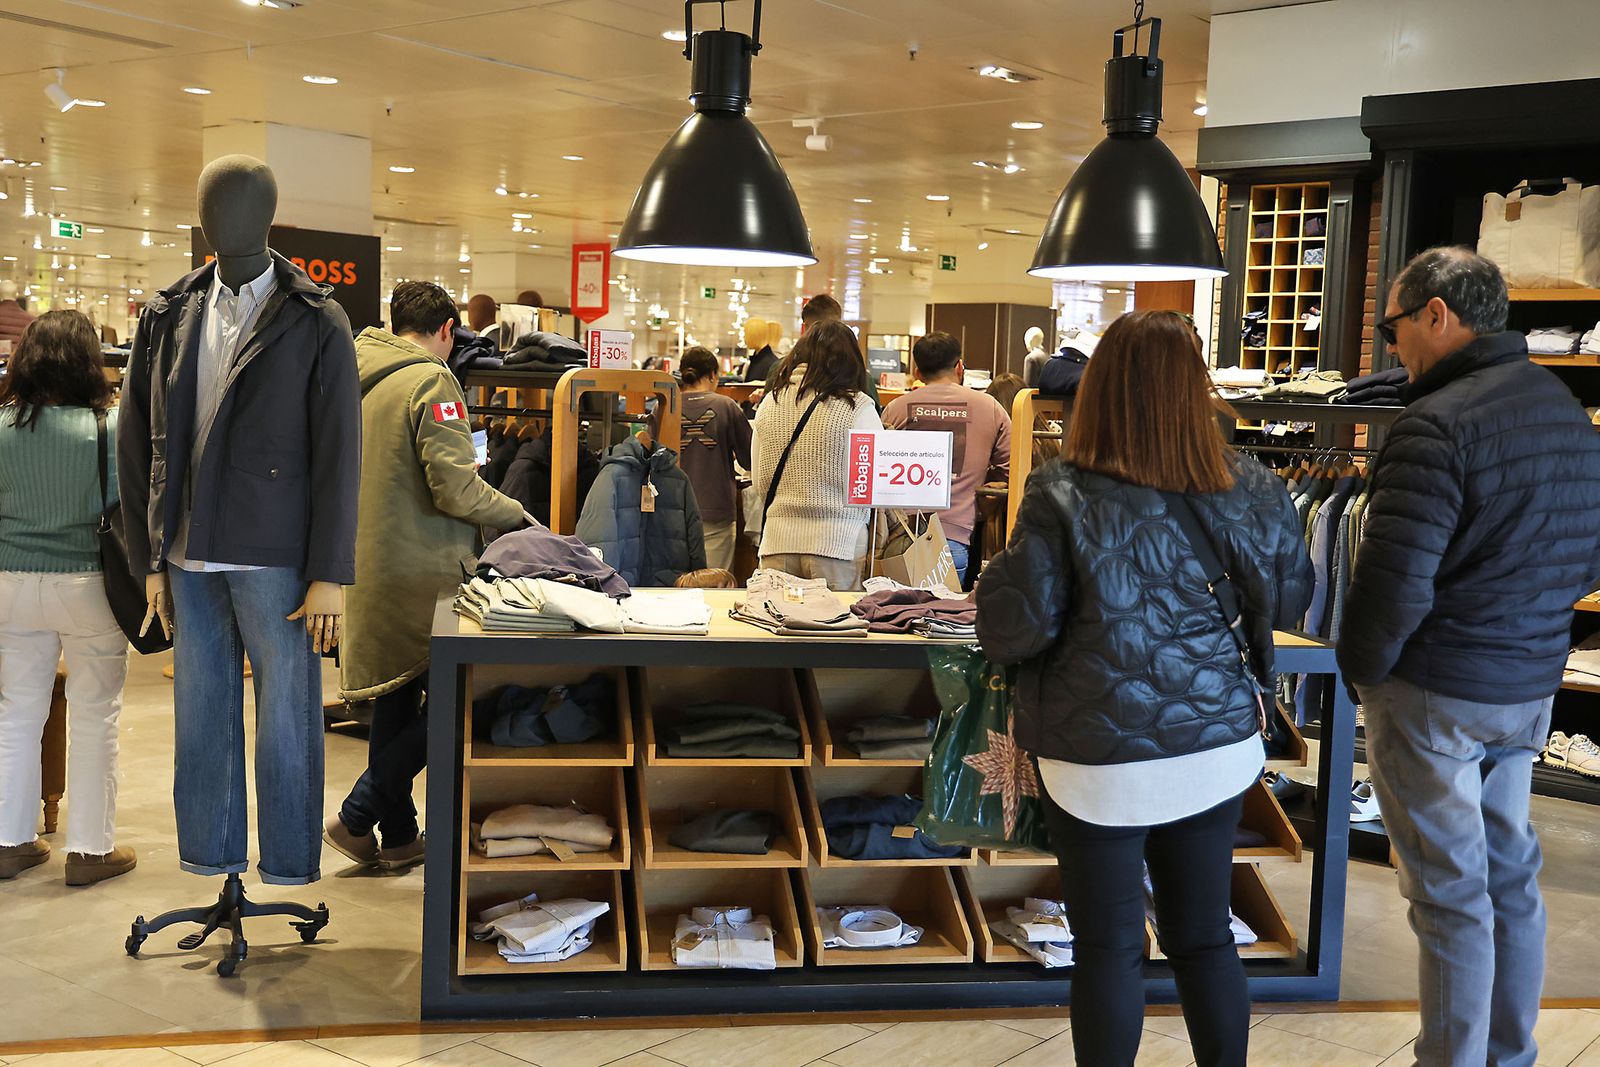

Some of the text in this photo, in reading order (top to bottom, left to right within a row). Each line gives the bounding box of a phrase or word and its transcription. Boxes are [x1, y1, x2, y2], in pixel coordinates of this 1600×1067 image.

[602, 346, 628, 360] -30%
[916, 407, 967, 420] Scalpers
[855, 444, 871, 499] rebajas
[879, 463, 942, 486] -20%
